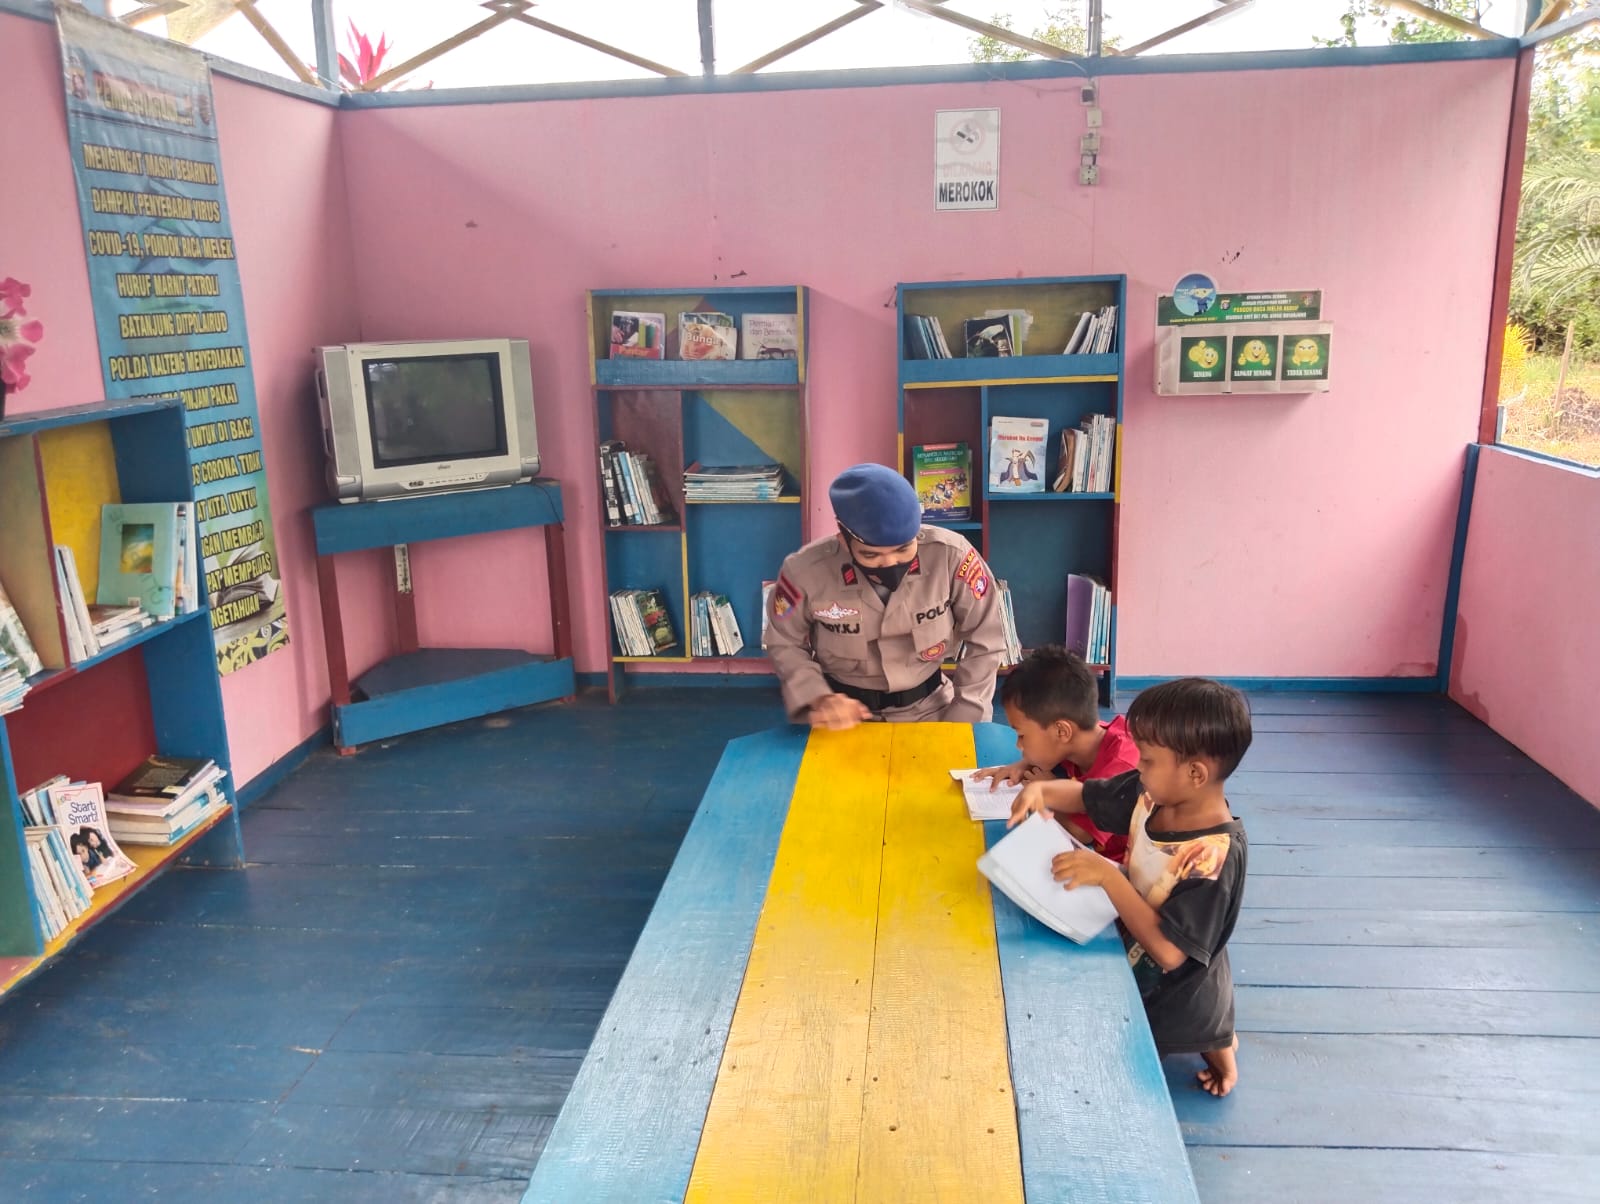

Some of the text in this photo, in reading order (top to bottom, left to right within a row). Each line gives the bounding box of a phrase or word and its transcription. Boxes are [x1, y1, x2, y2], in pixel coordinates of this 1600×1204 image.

[82, 143, 218, 185] MENGINGAT MASIH BESARNYA
[91, 187, 221, 223] DAMPAK PENYEBARAN VIRUS
[939, 180, 994, 202] MEROKOK
[88, 229, 144, 259] COVID-19,
[143, 233, 181, 258] PONDOK
[202, 237, 235, 260] MELEK
[116, 273, 152, 298] HURUF
[186, 274, 220, 297] PATROLI
[119, 312, 175, 339] BATANJUNG
[109, 346, 246, 381] POLDA KALTENG MENYEDIAKAN
[180, 383, 239, 412] PINJAM PAKAI
[190, 422, 218, 448] UNTUK
[217, 420, 229, 442] DI
[201, 455, 240, 483] CORONA
[237, 450, 262, 475] TIDAK
[207, 494, 229, 520] KITA
[221, 519, 264, 552] MEMBACA
[205, 569, 221, 594] PAT
[210, 591, 260, 630] NGETAHUAN
